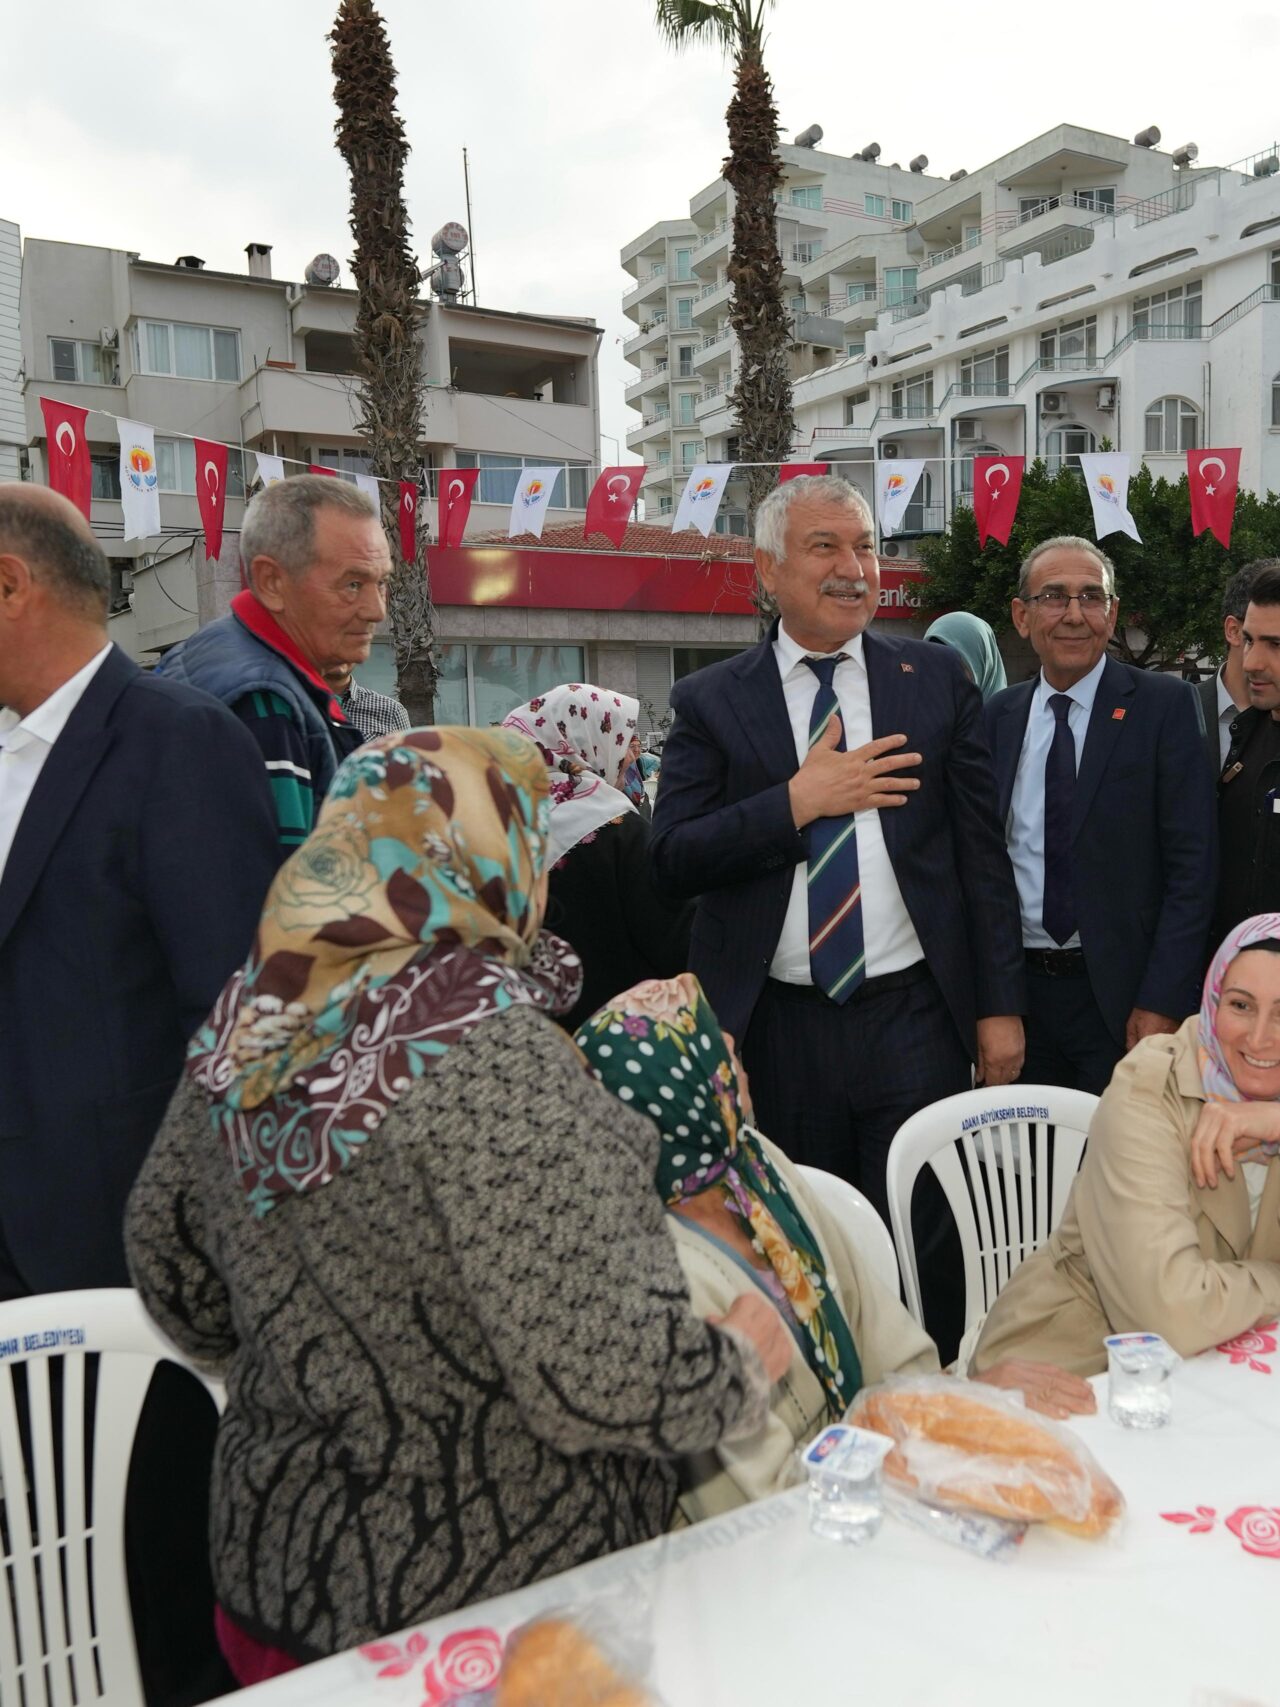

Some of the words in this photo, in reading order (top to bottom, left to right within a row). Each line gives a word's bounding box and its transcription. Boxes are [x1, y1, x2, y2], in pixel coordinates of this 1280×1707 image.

[878, 584, 922, 608] anka
[962, 1115, 979, 1131] ADANA
[980, 1106, 1015, 1125] BÜYÜKŞEHİR
[1016, 1105, 1049, 1119] BELEDİYESİ
